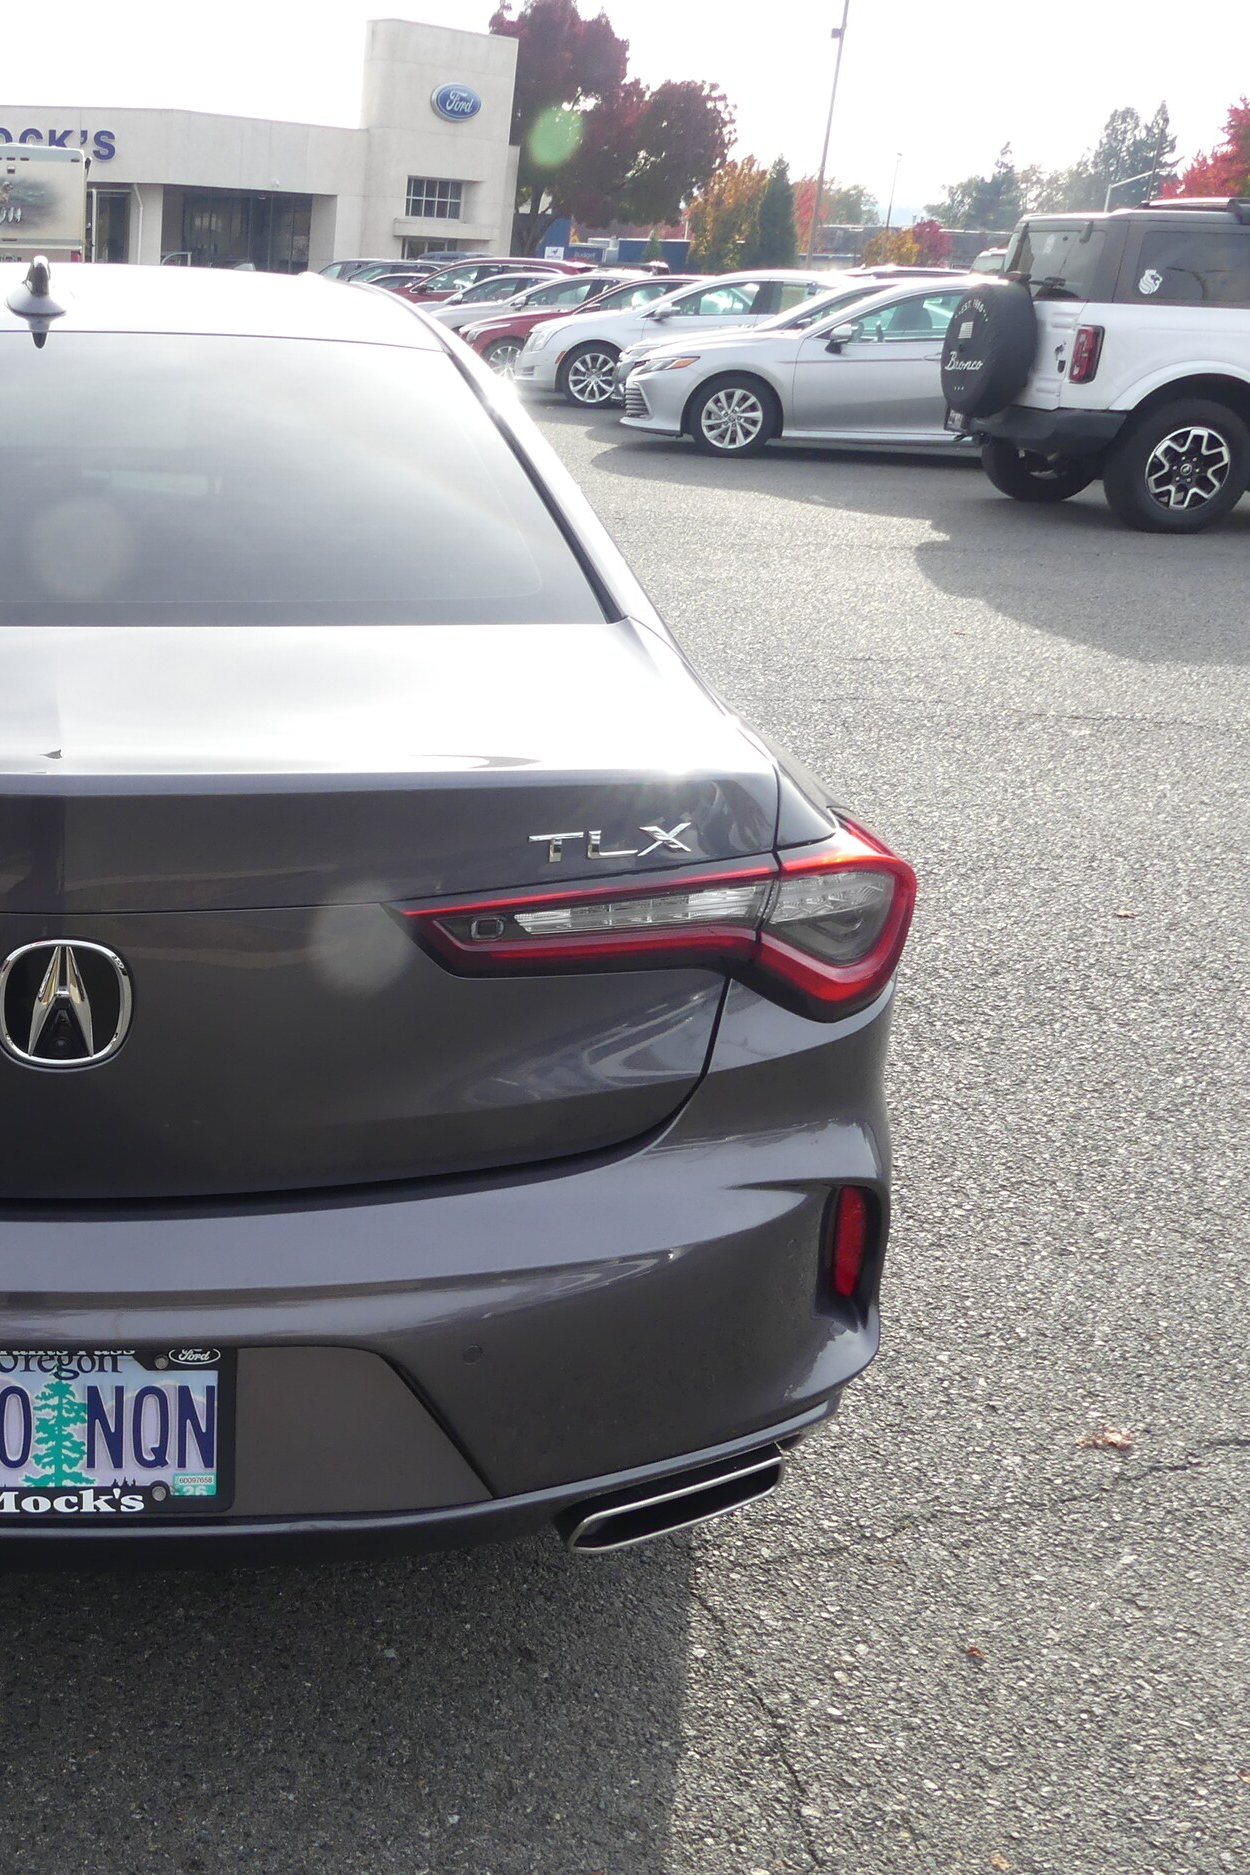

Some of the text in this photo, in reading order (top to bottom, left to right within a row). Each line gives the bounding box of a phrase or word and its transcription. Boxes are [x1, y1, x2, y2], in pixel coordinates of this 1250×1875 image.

[945, 351, 984, 371] Bronco
[528, 822, 692, 863] TLX
[178, 1348, 211, 1361] Ford
[86, 1385, 215, 1470] NQN
